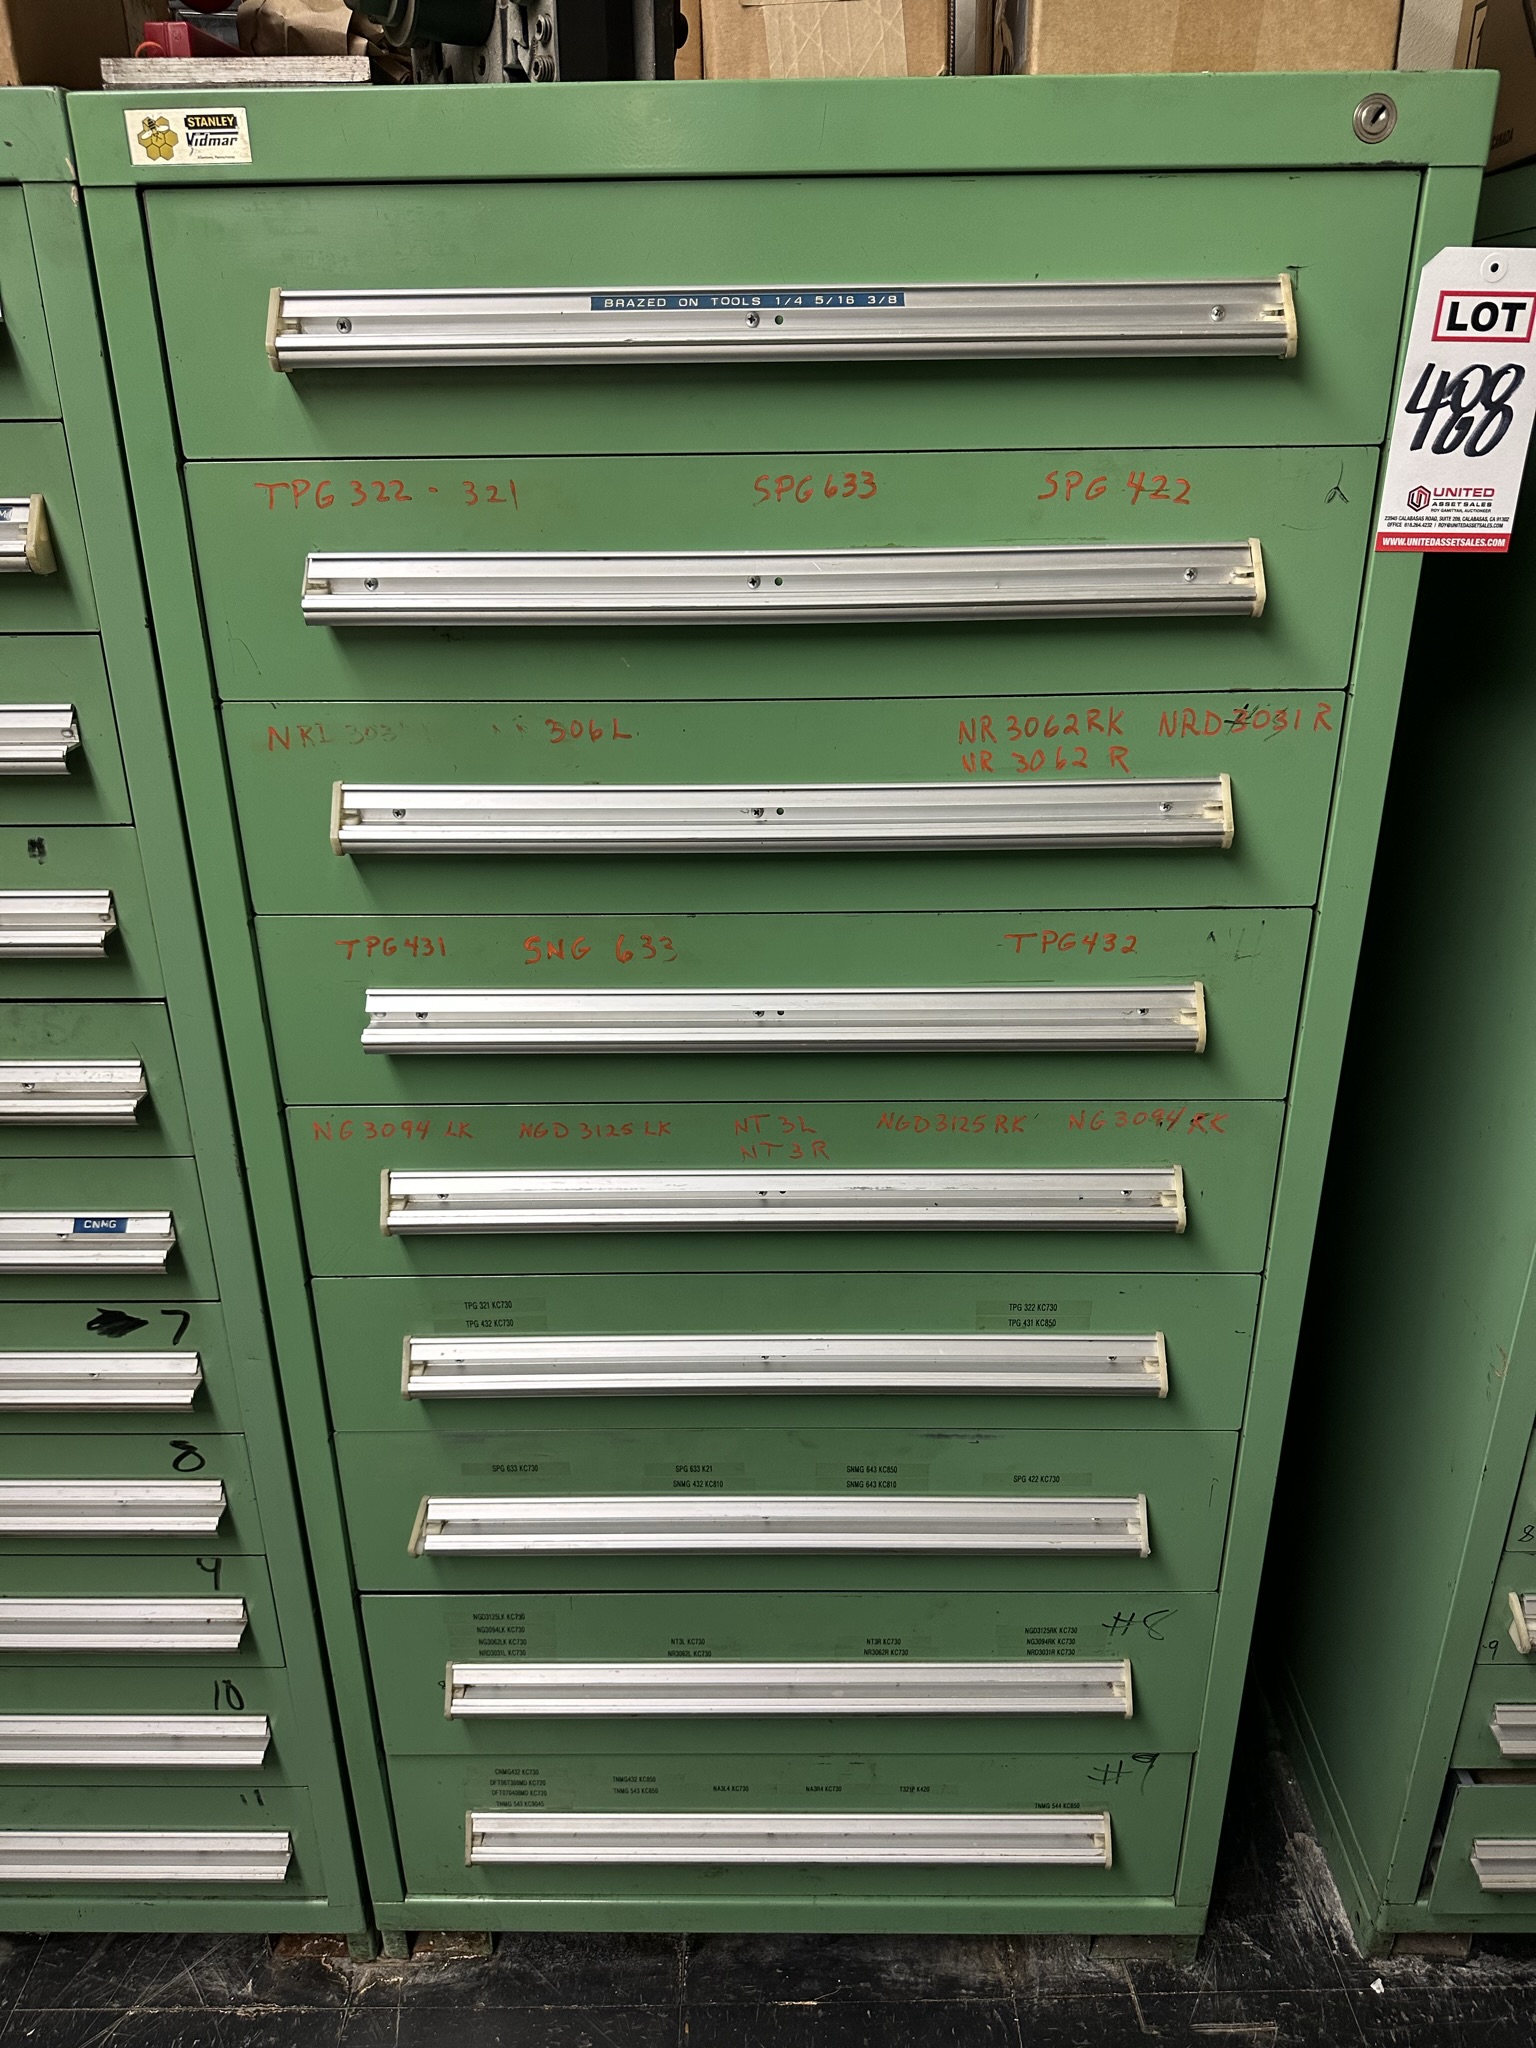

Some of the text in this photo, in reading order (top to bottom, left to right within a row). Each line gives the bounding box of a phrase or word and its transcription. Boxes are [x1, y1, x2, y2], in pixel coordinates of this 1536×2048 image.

[187, 116, 234, 127] STANLEY
[185, 132, 238, 147] Vidmar
[604, 295, 898, 308] BRAZED ON TOOLS 1/4 5/16 3/8
[1446, 302, 1526, 332] LOT
[1037, 470, 1190, 505] SPG 422
[254, 479, 335, 510] TPG
[350, 479, 412, 507] 322
[463, 479, 518, 511] 321
[1433, 487, 1495, 498] UNITED
[1382, 537, 1506, 547] WWW.UNITEDASSETSALES.COM
[524, 933, 679, 965] SNG 633
[83, 1219, 117, 1229] CNMG
[464, 1301, 513, 1310] TPG 321 KC730
[1009, 1303, 1058, 1311] TPG 322 KC730
[161, 1309, 190, 1345] 7
[466, 1319, 514, 1328] TPG 432 KC730
[1008, 1319, 1022, 1327] TPG
[1023, 1319, 1034, 1327] 431
[169, 1440, 205, 1472] 8
[492, 1464, 539, 1472] SPG 633 KC730
[675, 1465, 713, 1473] SPG 633 K21
[846, 1465, 865, 1473] SNMG
[866, 1465, 878, 1473] 643
[1013, 1475, 1060, 1483] SPG 422 KC730
[673, 1480, 691, 1488] SNMG
[692, 1480, 704, 1488] 432
[846, 1480, 864, 1488] SNMG
[865, 1480, 877, 1488] 643
[196, 1557, 222, 1591] 9
[1058, 1626, 1078, 1634] KC730
[882, 1637, 902, 1645] KC730
[890, 1648, 909, 1656] KC730
[1056, 1648, 1076, 1656] KC730
[214, 1679, 245, 1711] 10
